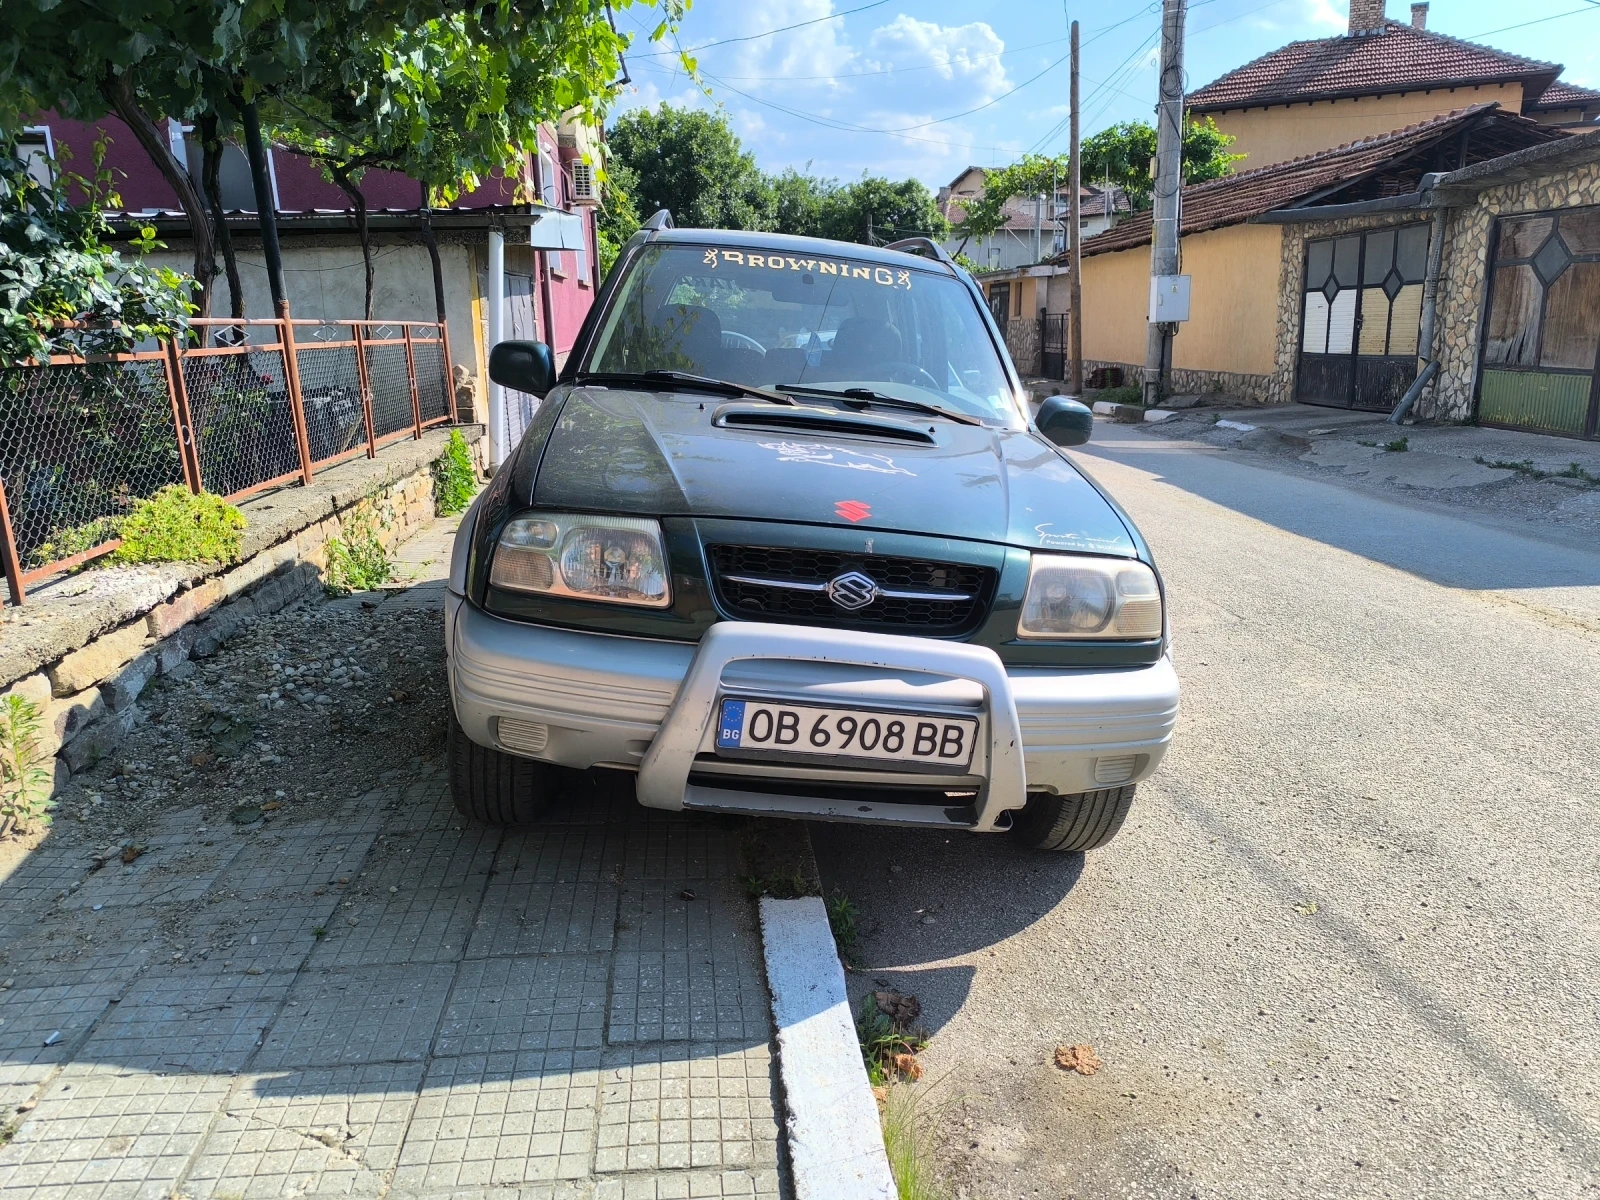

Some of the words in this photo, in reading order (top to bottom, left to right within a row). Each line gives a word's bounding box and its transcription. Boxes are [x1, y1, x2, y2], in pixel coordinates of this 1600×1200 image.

[723, 729, 740, 740] BG
[749, 709, 800, 744] OB
[809, 714, 905, 753] 6908
[912, 722, 964, 758] BB
